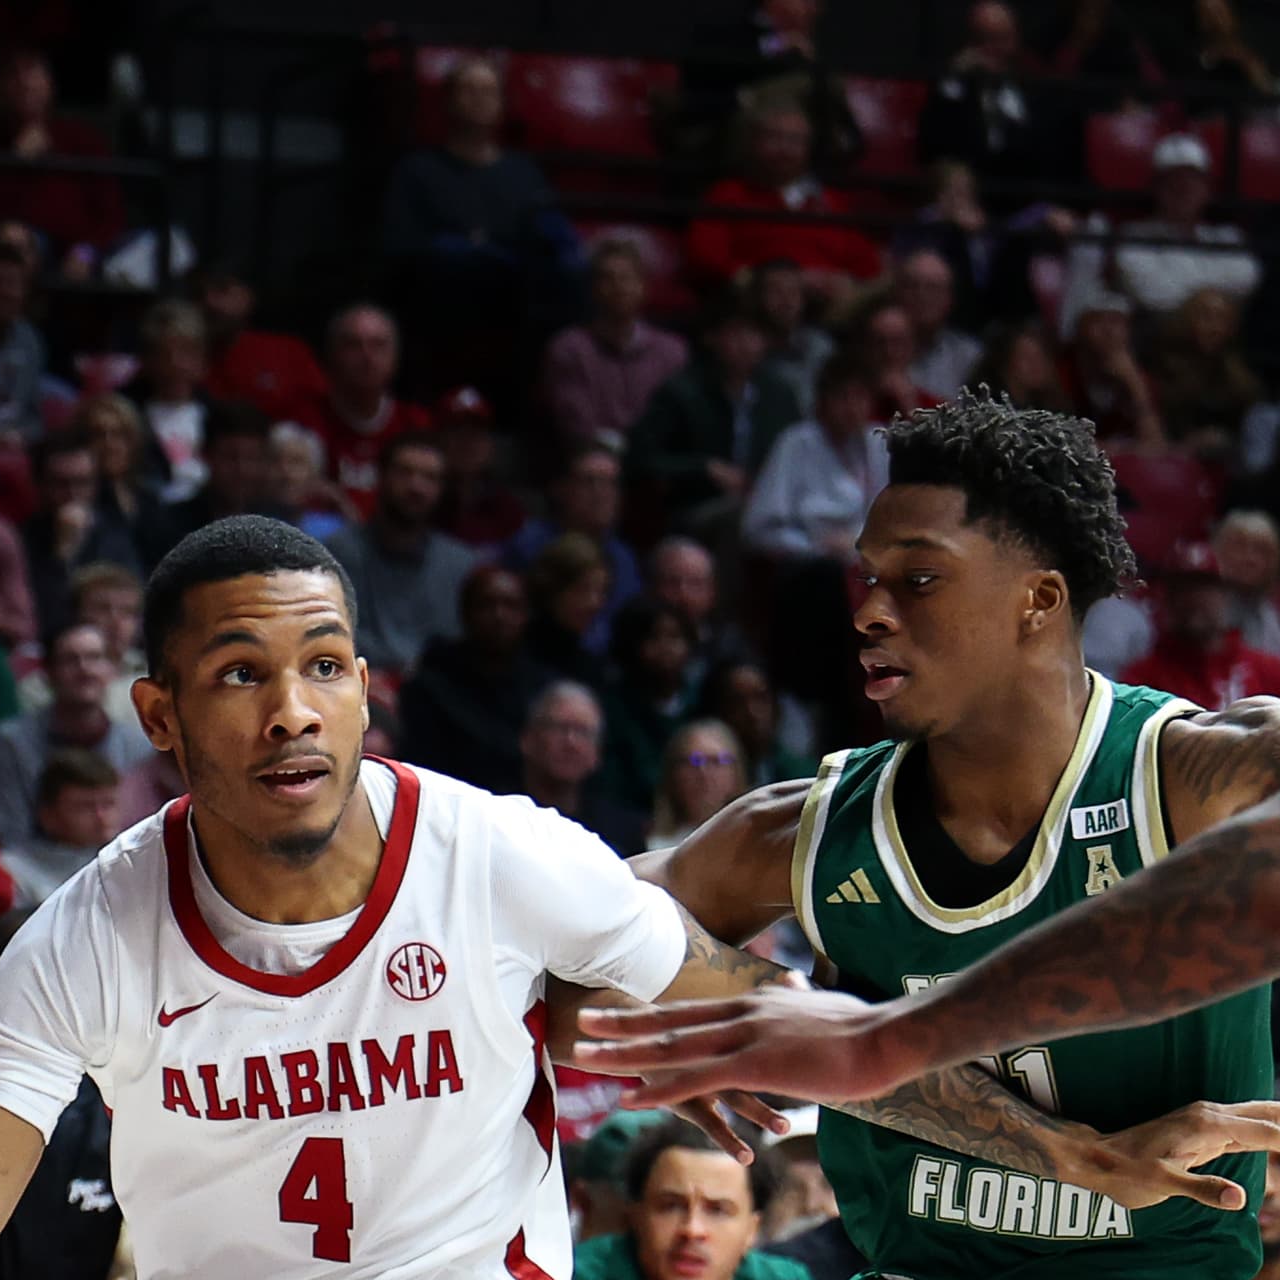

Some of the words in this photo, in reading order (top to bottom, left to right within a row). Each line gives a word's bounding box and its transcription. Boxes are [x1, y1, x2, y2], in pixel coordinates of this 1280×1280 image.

[1084, 805, 1120, 835] AAR
[387, 943, 445, 1000] SEC
[161, 1029, 465, 1121] ALABAMA
[278, 1136, 355, 1264] 4
[907, 1152, 1135, 1241] FLORIDA
